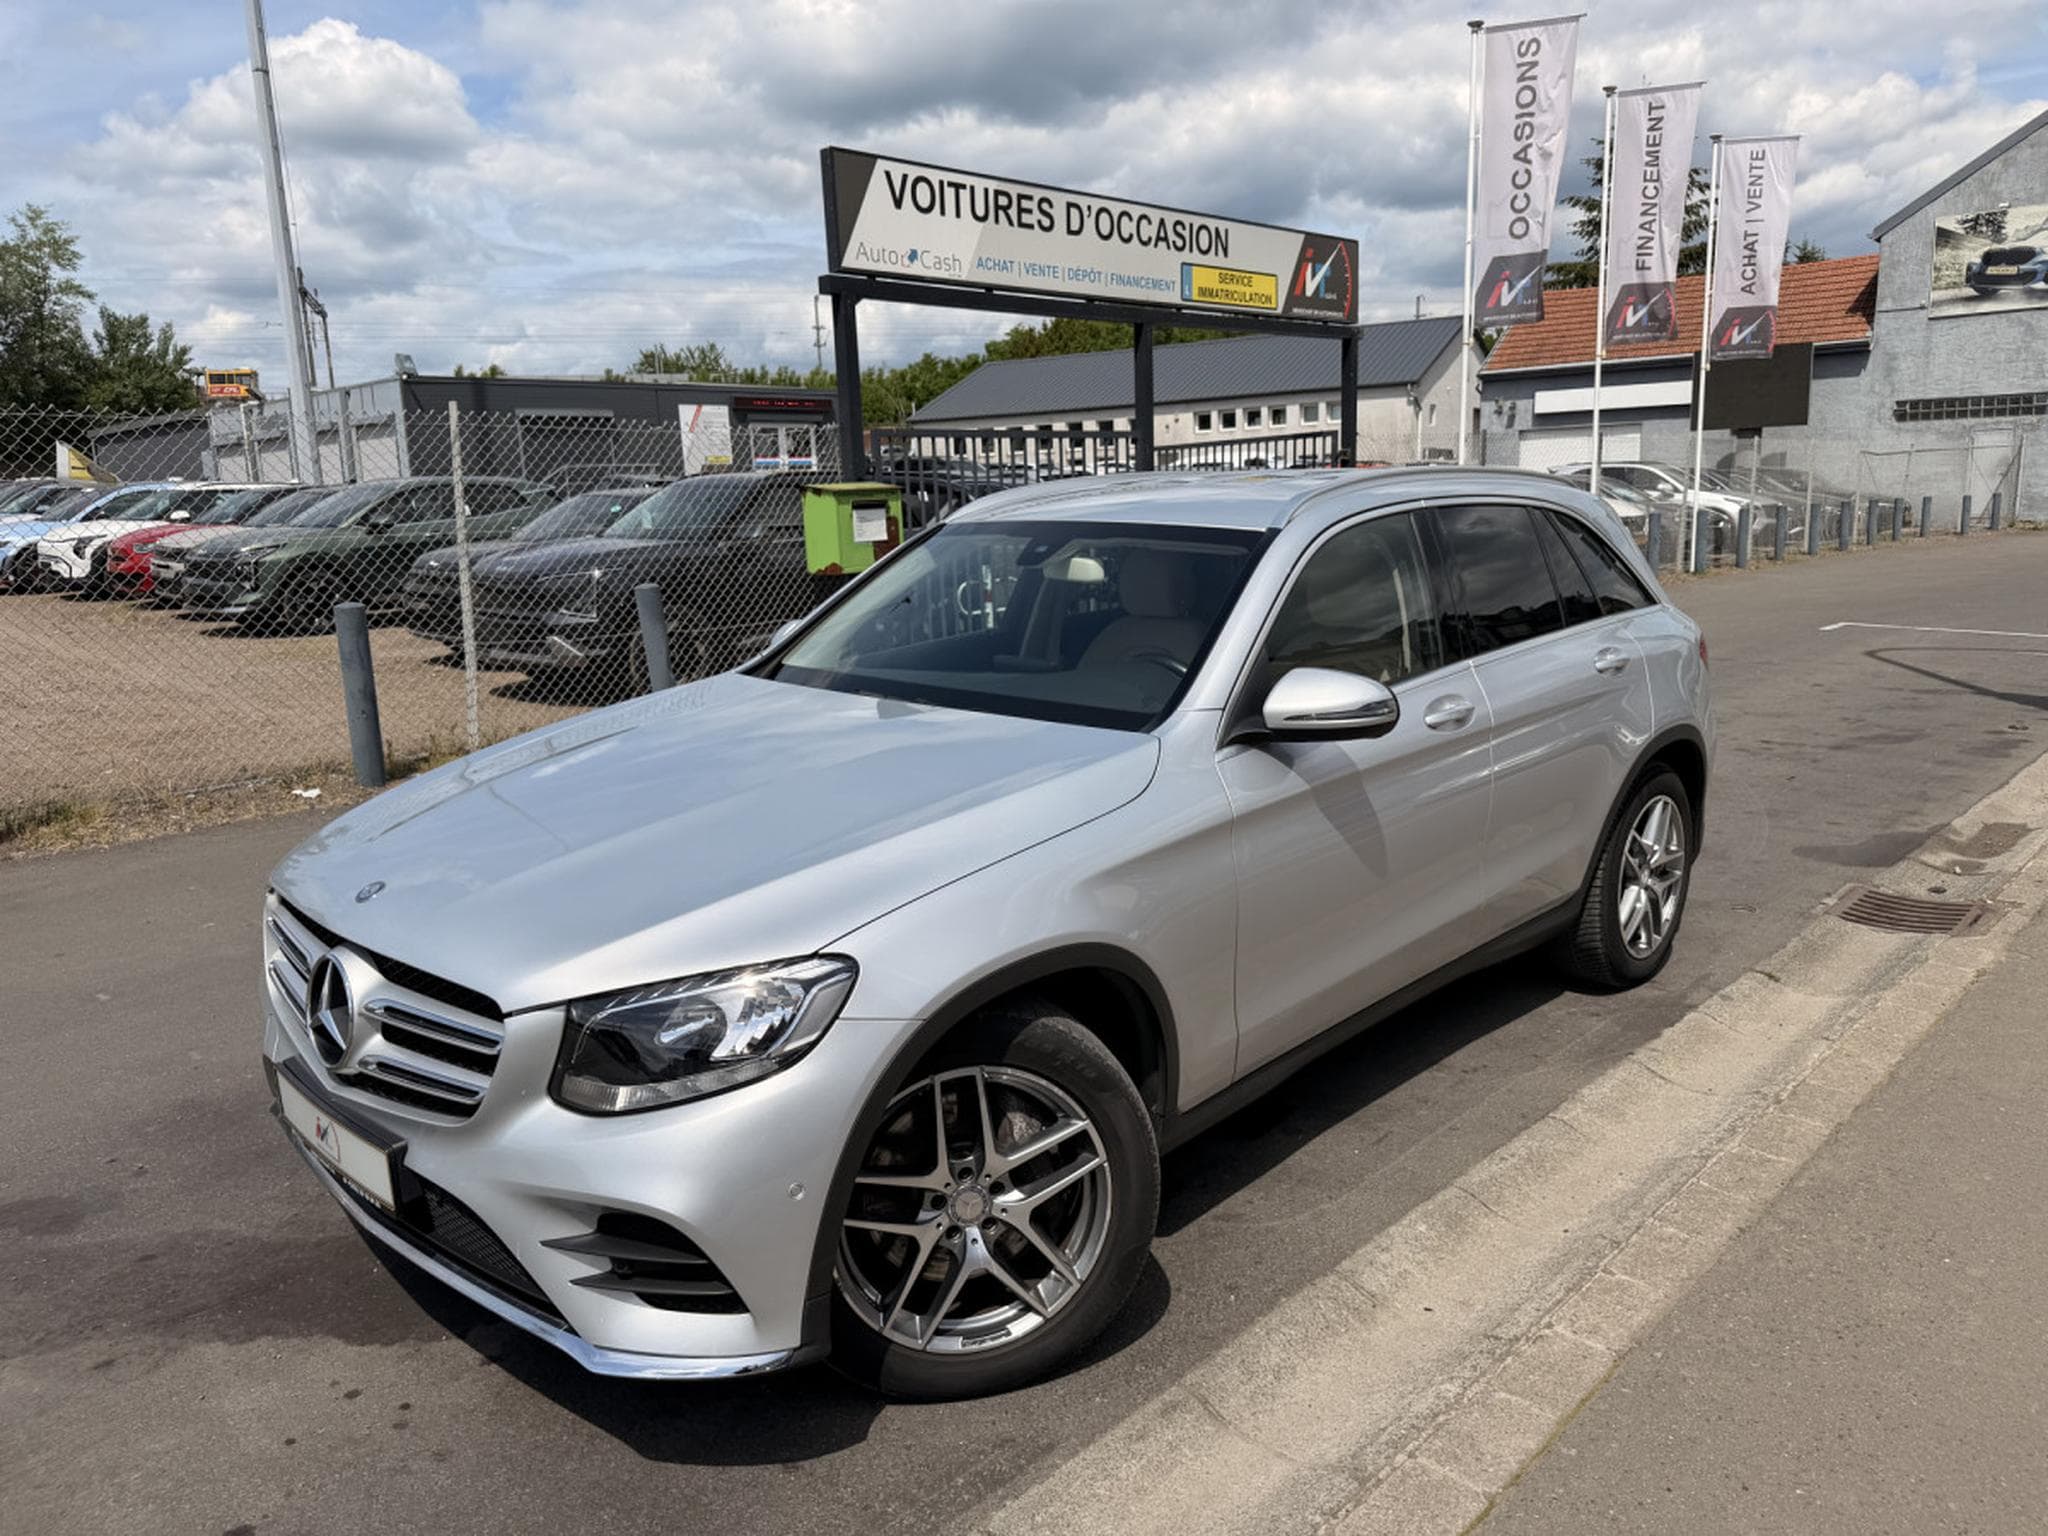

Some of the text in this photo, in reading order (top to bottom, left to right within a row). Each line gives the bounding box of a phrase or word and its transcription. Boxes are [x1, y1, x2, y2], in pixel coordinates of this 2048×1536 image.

[1509, 36, 1542, 240] OCCASIONS
[884, 170, 1229, 259] VOITURES D'OCCASION
[1635, 100, 1666, 272] FINANCEMENT
[1740, 149, 1766, 296] ACHAT VENTE
[855, 242, 962, 273] Auto Cash
[976, 256, 1015, 274] ACHAT
[1024, 262, 1060, 280] VENTE
[1110, 272, 1176, 293] FINANCEMENT
[1218, 272, 1253, 288] SERVICE
[1198, 286, 1273, 305] IMMATRICULATION
